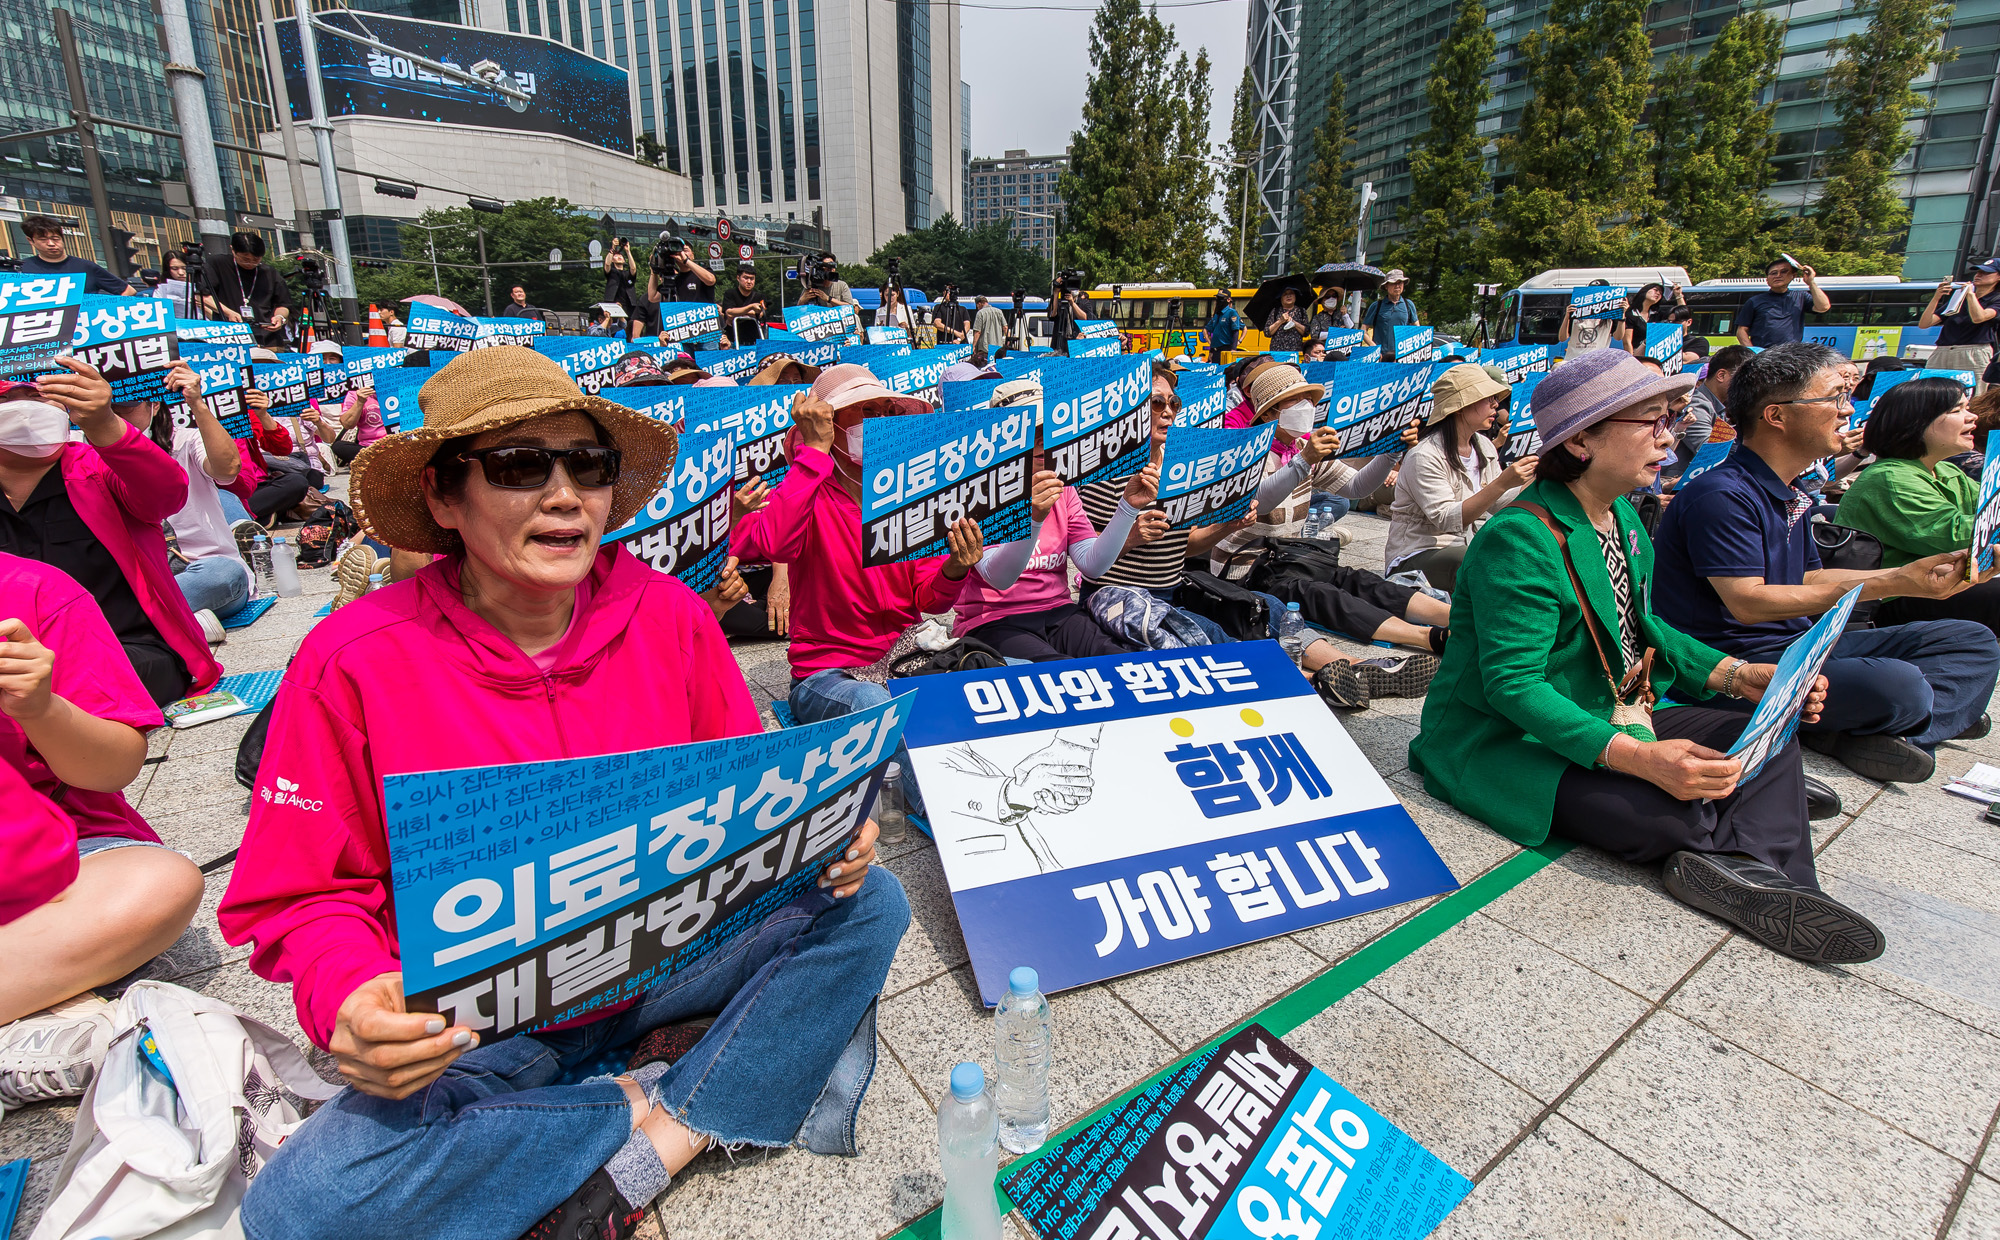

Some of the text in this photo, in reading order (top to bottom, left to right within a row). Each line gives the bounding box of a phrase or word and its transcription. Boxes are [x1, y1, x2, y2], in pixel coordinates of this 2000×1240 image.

[720, 224, 728, 235] 50
[741, 247, 751, 257] 50
[1574, 287, 1626, 306] 의료정상화
[411, 317, 476, 339] 의료정상화
[666, 305, 717, 327] 의료정상화
[669, 318, 719, 342] 재발방지법
[790, 309, 839, 333] 의료정상화
[179, 325, 248, 338] 의료정상화
[408, 333, 472, 352] 재발방지법
[1327, 332, 1363, 348] 의료정상화
[1398, 328, 1432, 355] 의료정상화
[1501, 359, 1547, 384] 발방지법
[1051, 357, 1151, 438] 의료정상화
[1334, 364, 1432, 424] 의료정상화
[1334, 395, 1420, 456] 재발방지법
[1051, 399, 1151, 481] 재발방지법
[872, 410, 1031, 510] 의료정상화
[1166, 423, 1274, 491] 의료정상화
[1163, 457, 1265, 525] 재발방지법
[871, 457, 1026, 558] 재발방지법
[963, 655, 1259, 725] 의사와 환자는
[455, 793, 499, 820] 의사
[504, 767, 586, 807] 집단휴진
[591, 752, 630, 780] 철회
[498, 806, 541, 832] 의사
[546, 776, 624, 813] 집단휴진
[629, 764, 666, 790] 철회
[671, 755, 689, 774] 및
[694, 740, 732, 767] 재발
[1164, 731, 1333, 820] 함께
[409, 781, 455, 808] 의사
[392, 836, 518, 892] 환자촉구대회
[539, 815, 580, 842] 의사
[585, 787, 660, 828] 집단휴진
[664, 773, 700, 800] 철회
[705, 766, 723, 786] 및
[727, 750, 762, 775] 재발
[765, 727, 814, 761] 방지법
[433, 703, 900, 967] 의료정상화
[438, 775, 872, 1033] 재발방지법
[1072, 830, 1390, 958] 가야 합니다
[624, 964, 656, 991] 철회
[1165, 1084, 1185, 1106] 철회
[1124, 1097, 1151, 1127] 방지법
[1143, 1110, 1164, 1133] 재발
[1109, 1122, 1130, 1147] 제정
[1122, 1128, 1150, 1161] 방지법
[1063, 1140, 1114, 1204] 환자촉구대회
[1106, 1155, 1128, 1181] 제정
[1042, 1170, 1064, 1197] 의사
[1038, 1205, 1061, 1232] 의사
[1058, 1174, 1112, 1240] 환자촉구대회
